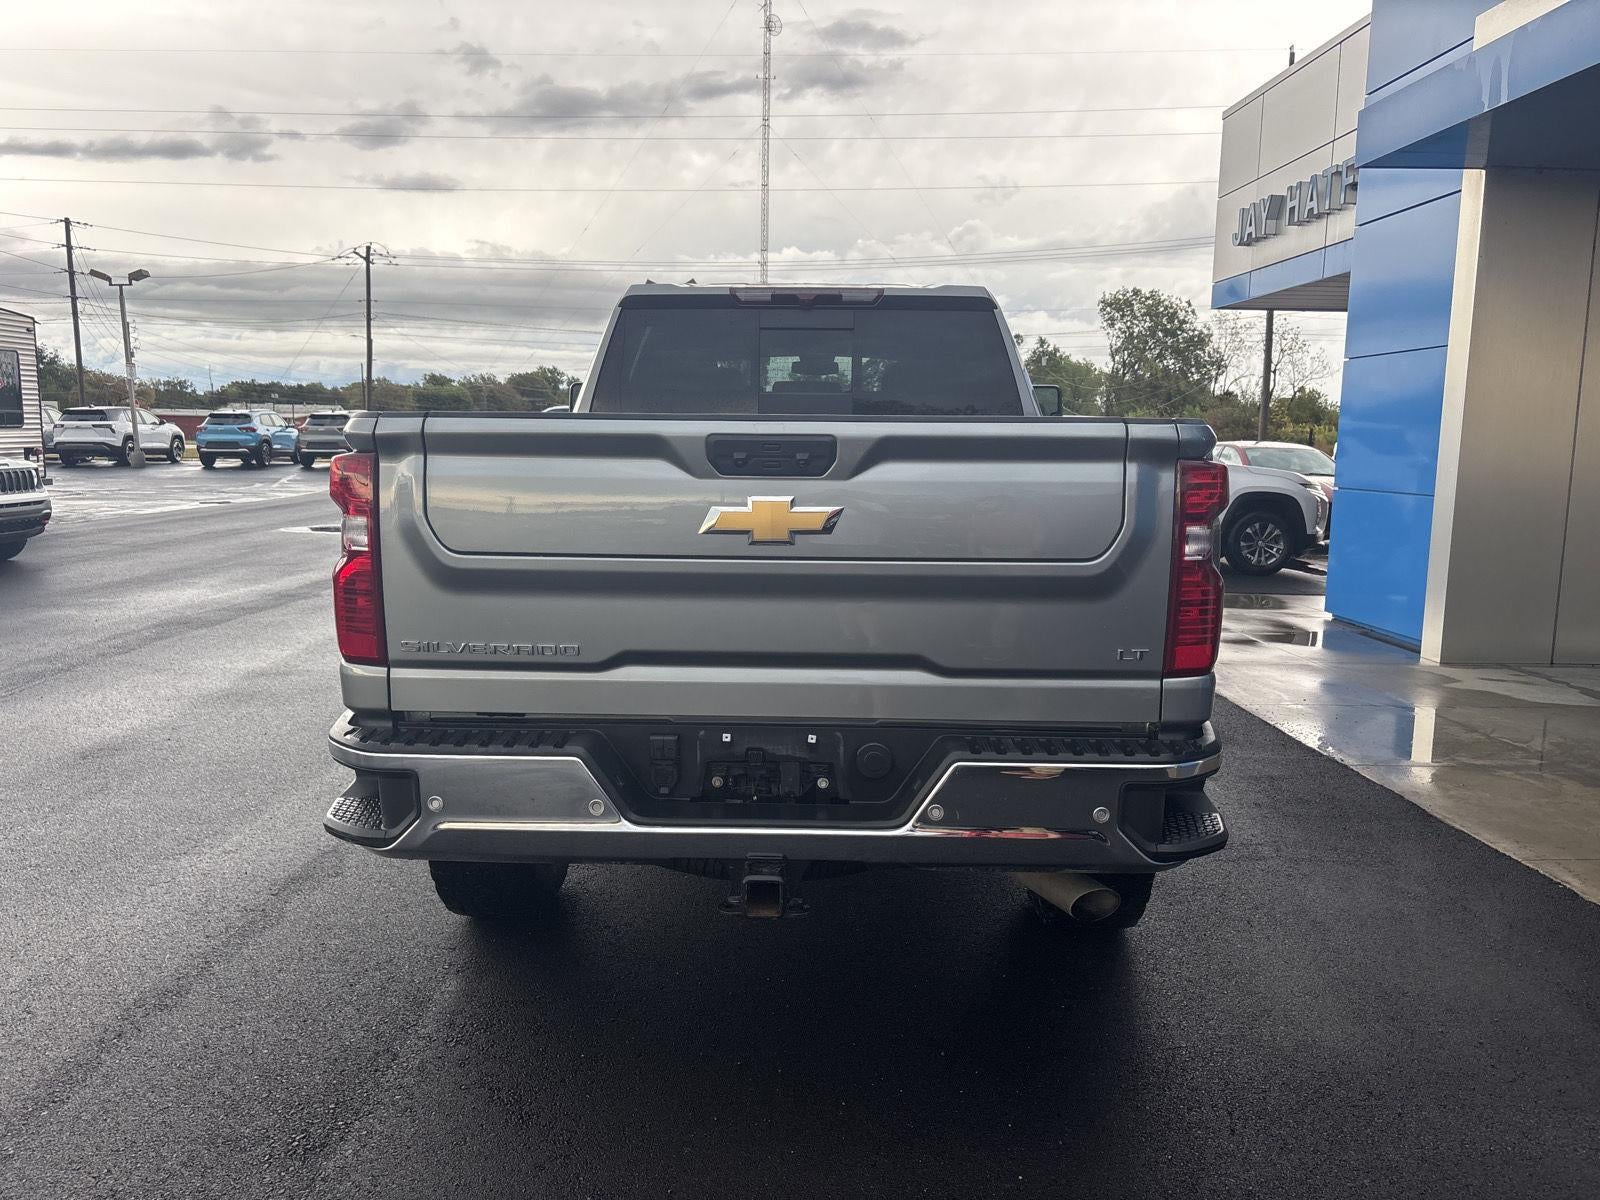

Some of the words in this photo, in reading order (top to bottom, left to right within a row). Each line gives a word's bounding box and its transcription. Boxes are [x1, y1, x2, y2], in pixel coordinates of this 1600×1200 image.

[1231, 195, 1280, 246] JAY
[400, 640, 581, 656] SILVERADO
[1116, 648, 1150, 661] LT
